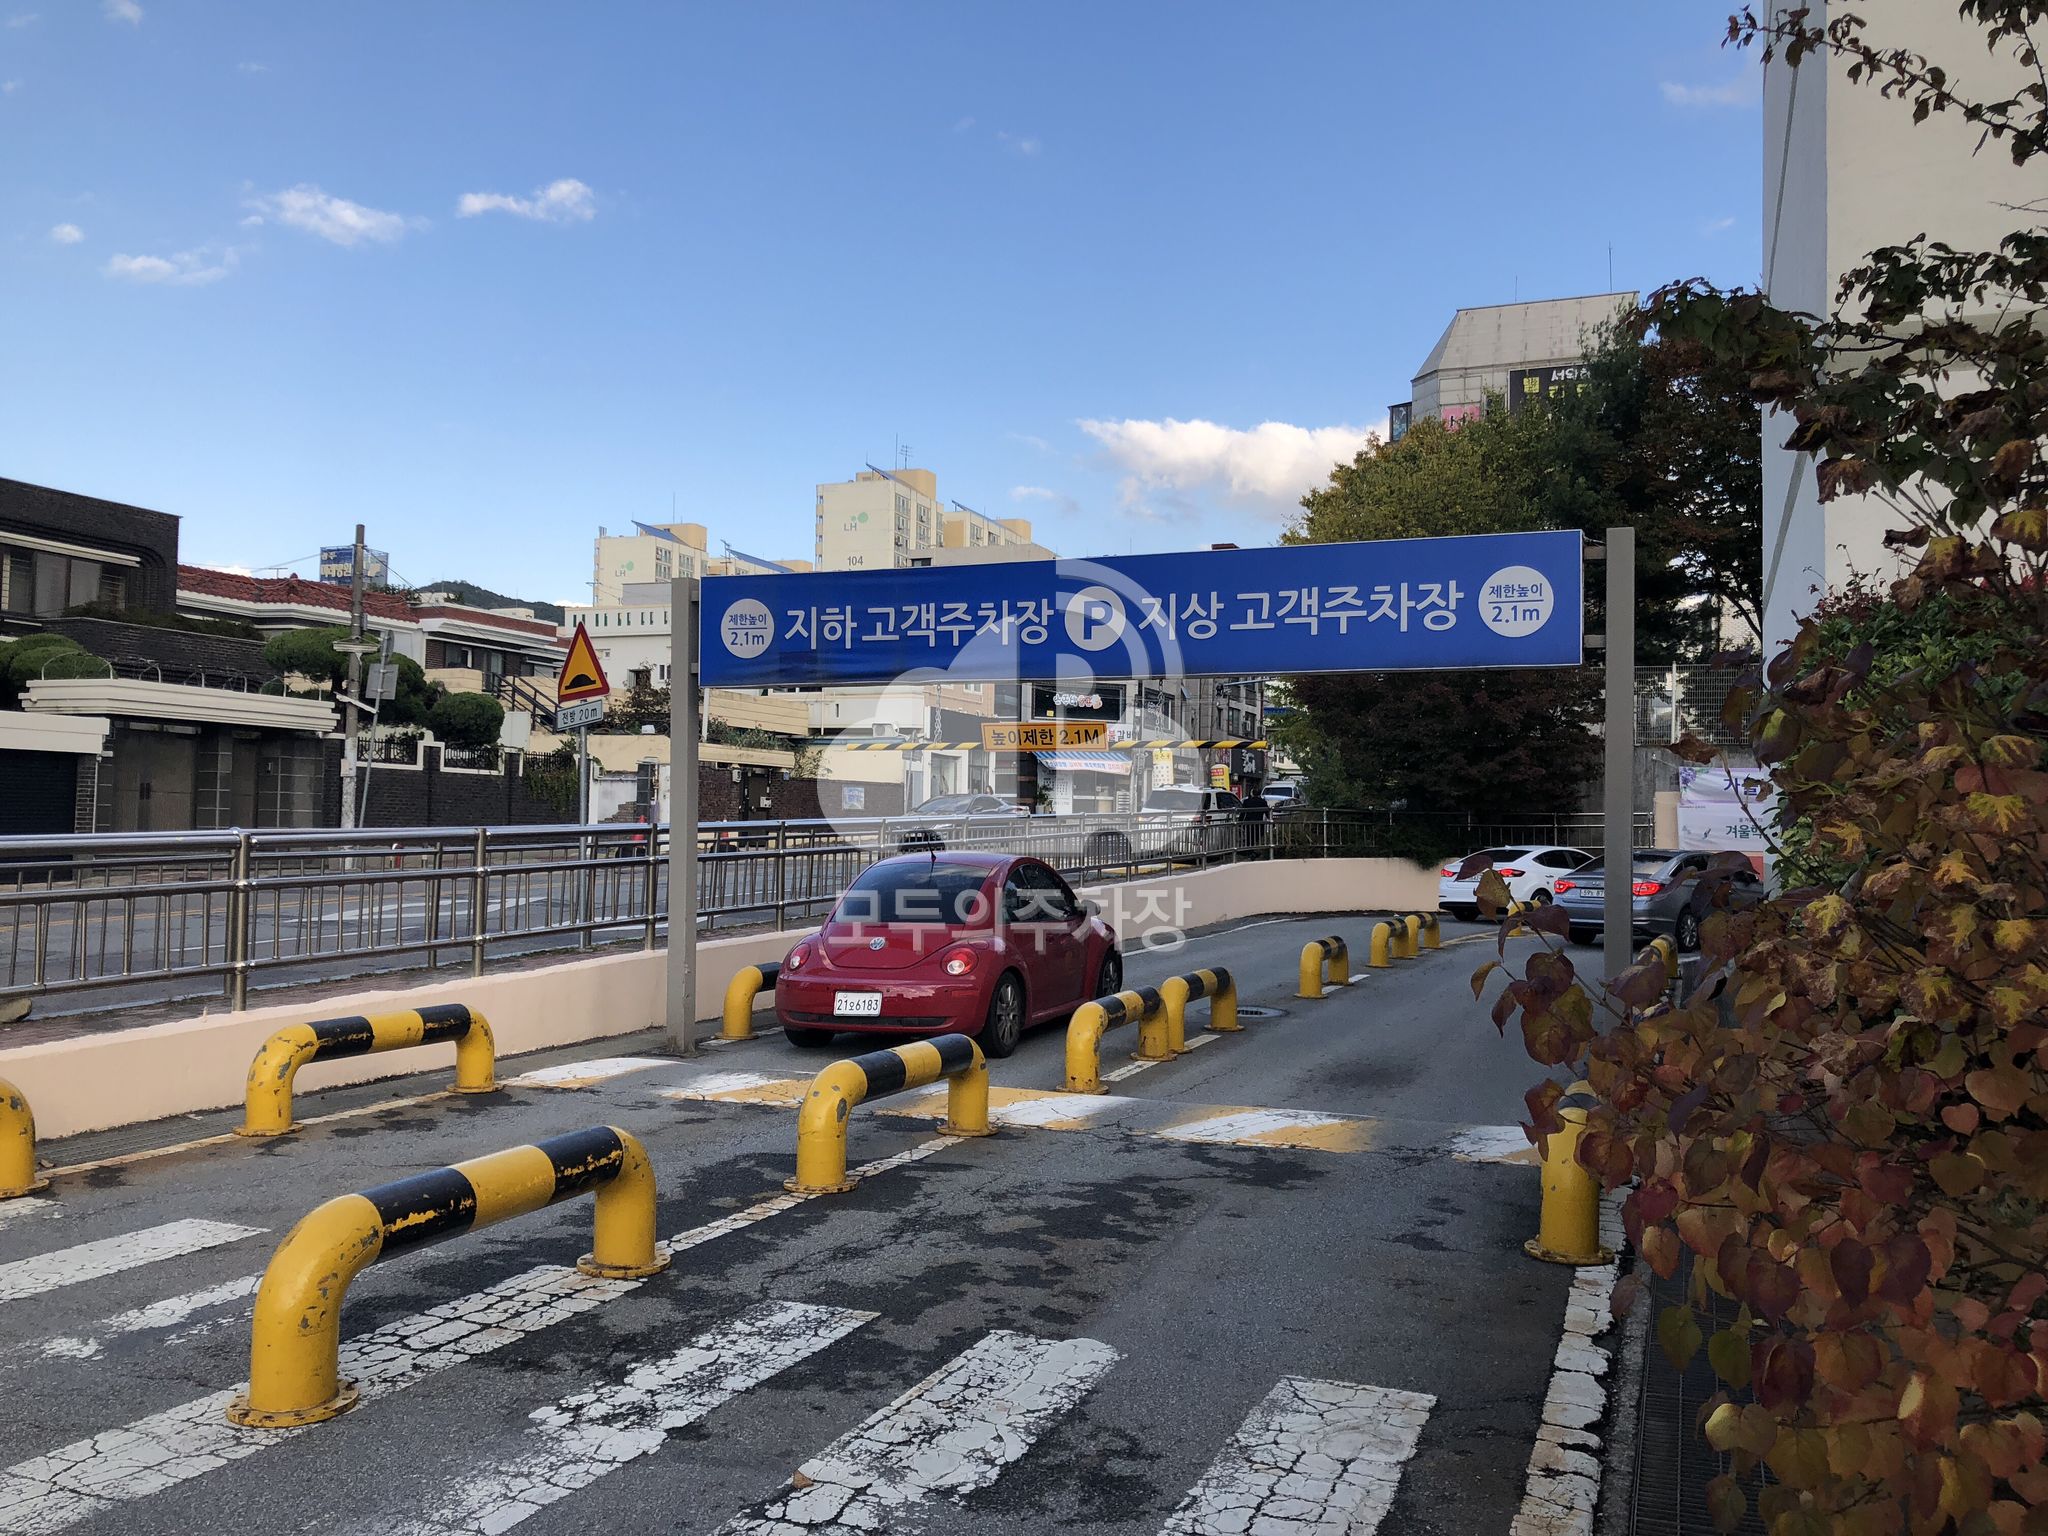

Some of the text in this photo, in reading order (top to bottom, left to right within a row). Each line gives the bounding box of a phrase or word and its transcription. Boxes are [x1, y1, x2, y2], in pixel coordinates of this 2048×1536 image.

[844, 522, 857, 531] LH
[848, 555, 864, 566] 104
[615, 569, 625, 577] LH
[1488, 582, 1543, 599] 제한높이
[728, 613, 767, 626] 제한높이
[784, 579, 1465, 650] 지하 고객주차장 P 지상 고객주차장
[1491, 604, 1540, 623] 2.1m
[730, 631, 765, 646] 2.1m
[562, 708, 598, 725] 전방 20m
[991, 728, 1100, 746] 높이제한 2.1M
[837, 999, 879, 1011] 21오6183
